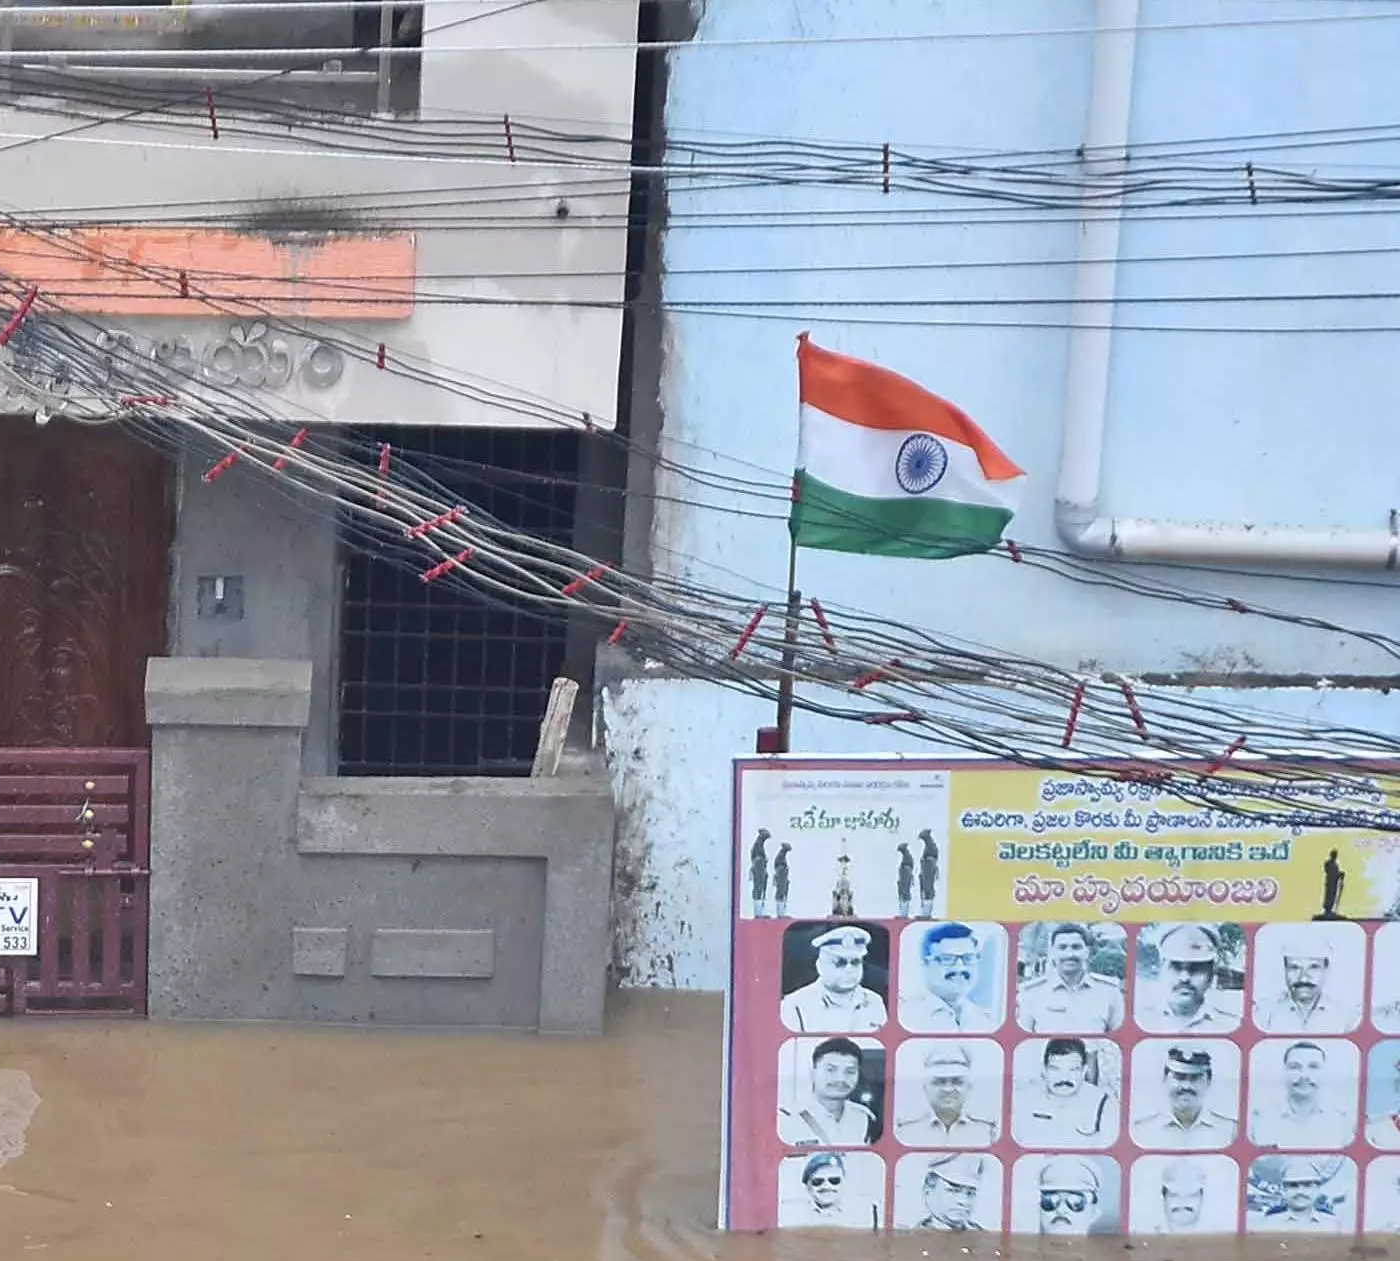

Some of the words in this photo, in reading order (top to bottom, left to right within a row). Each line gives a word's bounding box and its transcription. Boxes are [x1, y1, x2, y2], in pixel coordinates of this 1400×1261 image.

[1032, 811, 1070, 833] ప్రజల
[1074, 811, 1119, 828] కొరకు
[1123, 808, 1142, 828] మీ
[1113, 840, 1138, 860] మీ
[1015, 875, 1065, 902] మా
[1073, 875, 1279, 913] హృదయాంజలి
[1, 924, 29, 932] Service
[3, 936, 27, 950] 533
